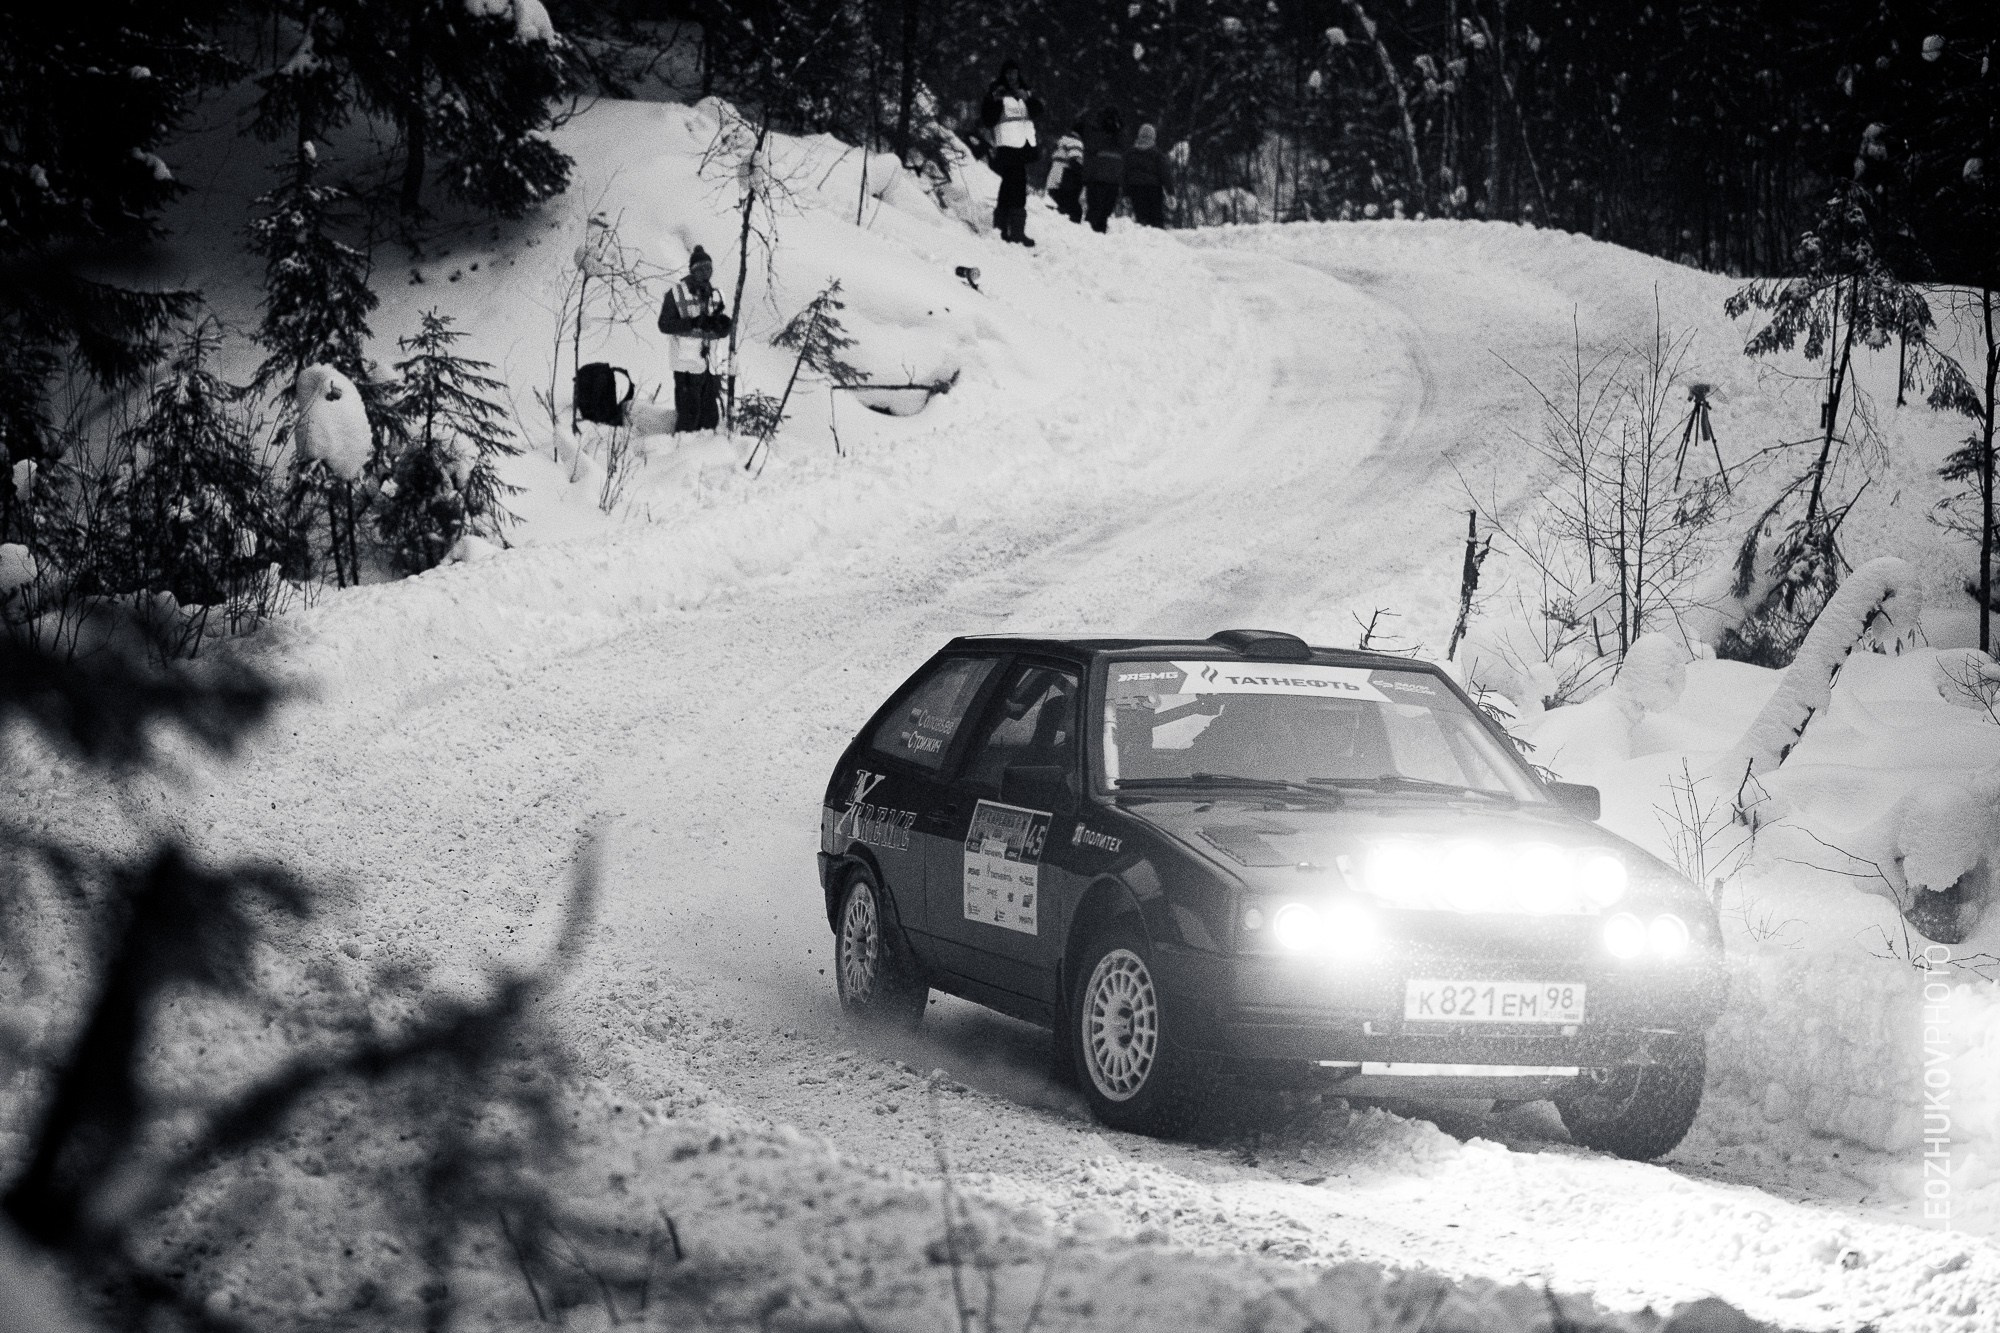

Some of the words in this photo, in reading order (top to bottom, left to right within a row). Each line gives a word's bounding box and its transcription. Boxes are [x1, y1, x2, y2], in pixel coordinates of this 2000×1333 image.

[1225, 675, 1360, 691] ТАТНЕФТЬ
[1025, 824, 1047, 856] 45
[1082, 829, 1123, 853] ПОЛИТЕХ
[1547, 987, 1574, 1009] 98
